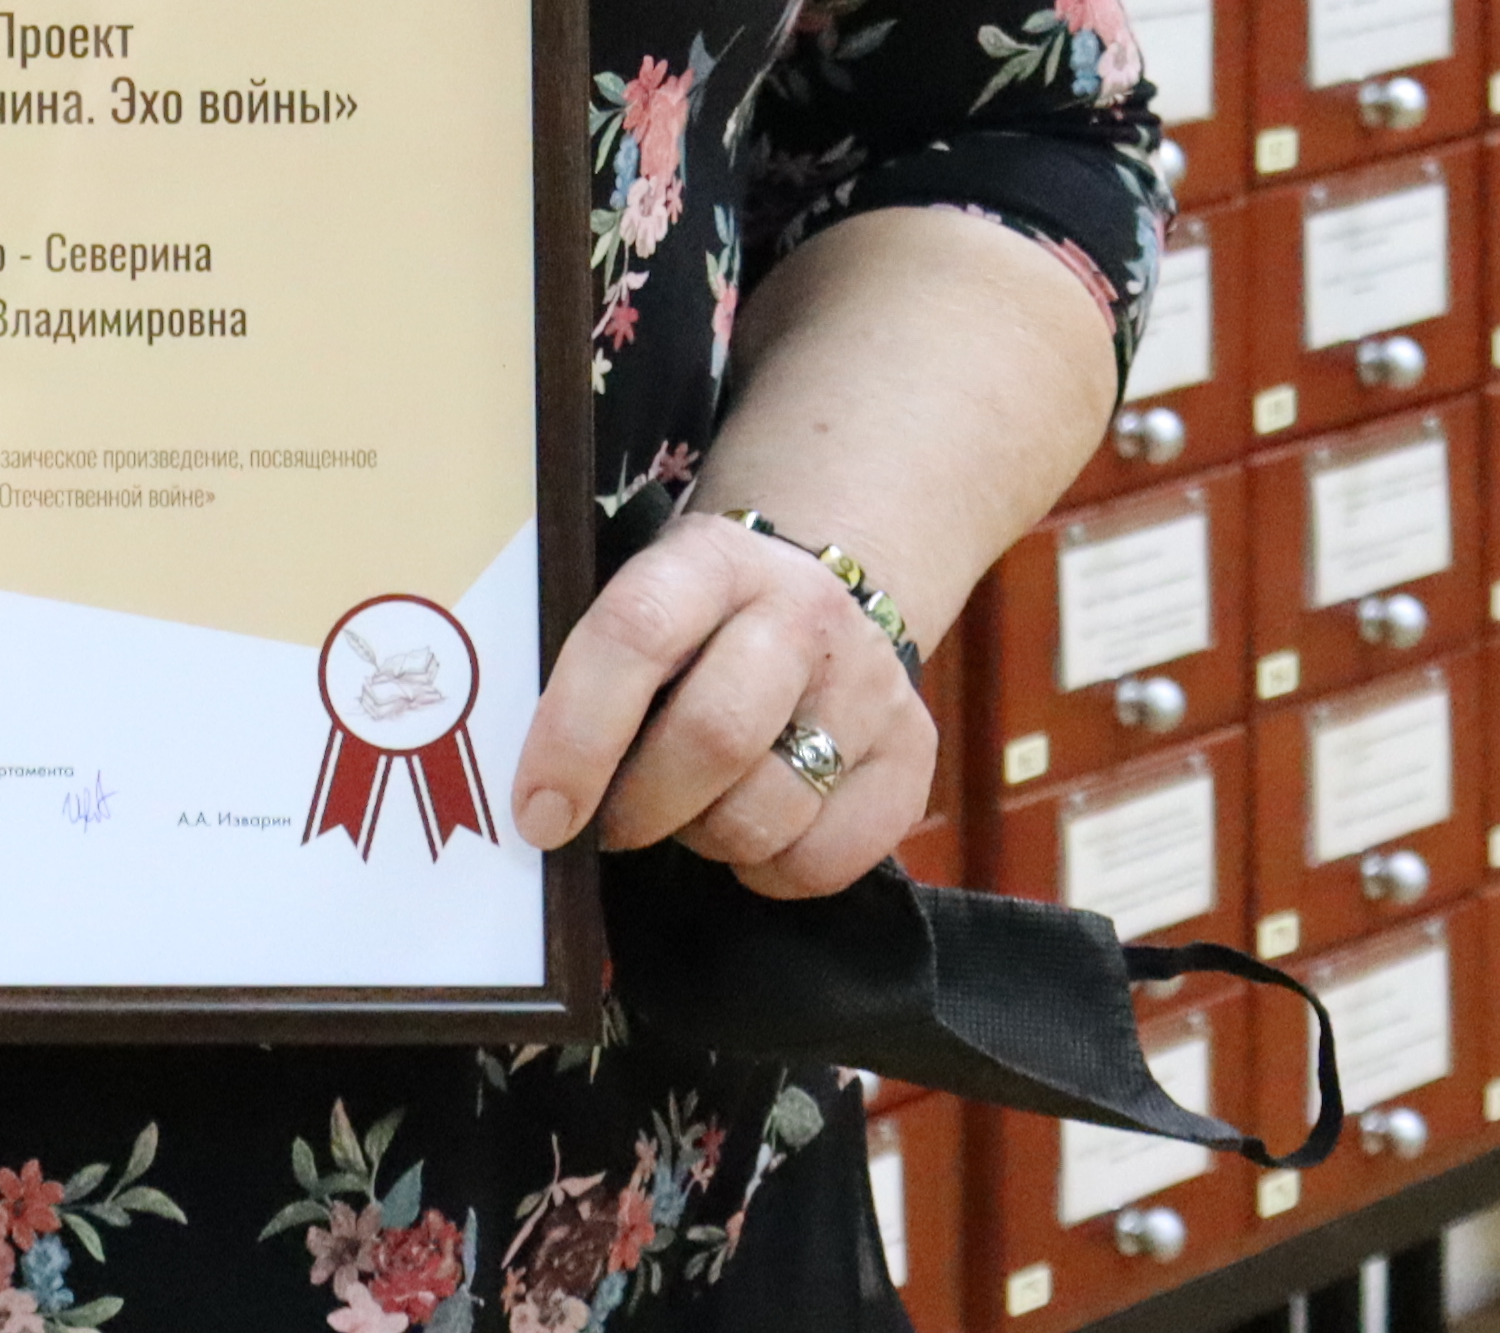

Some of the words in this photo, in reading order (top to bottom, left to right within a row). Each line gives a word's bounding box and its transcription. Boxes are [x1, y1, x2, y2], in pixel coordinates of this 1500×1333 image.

[110, 76, 183, 125] Эхо
[199, 77, 358, 125] войны»
[45, 232, 212, 282] Северина
[102, 449, 244, 474] произведение,
[249, 448, 378, 471] посвященное
[148, 484, 216, 509] войне»
[177, 810, 213, 828] А.А.
[217, 811, 292, 831] Изварин
